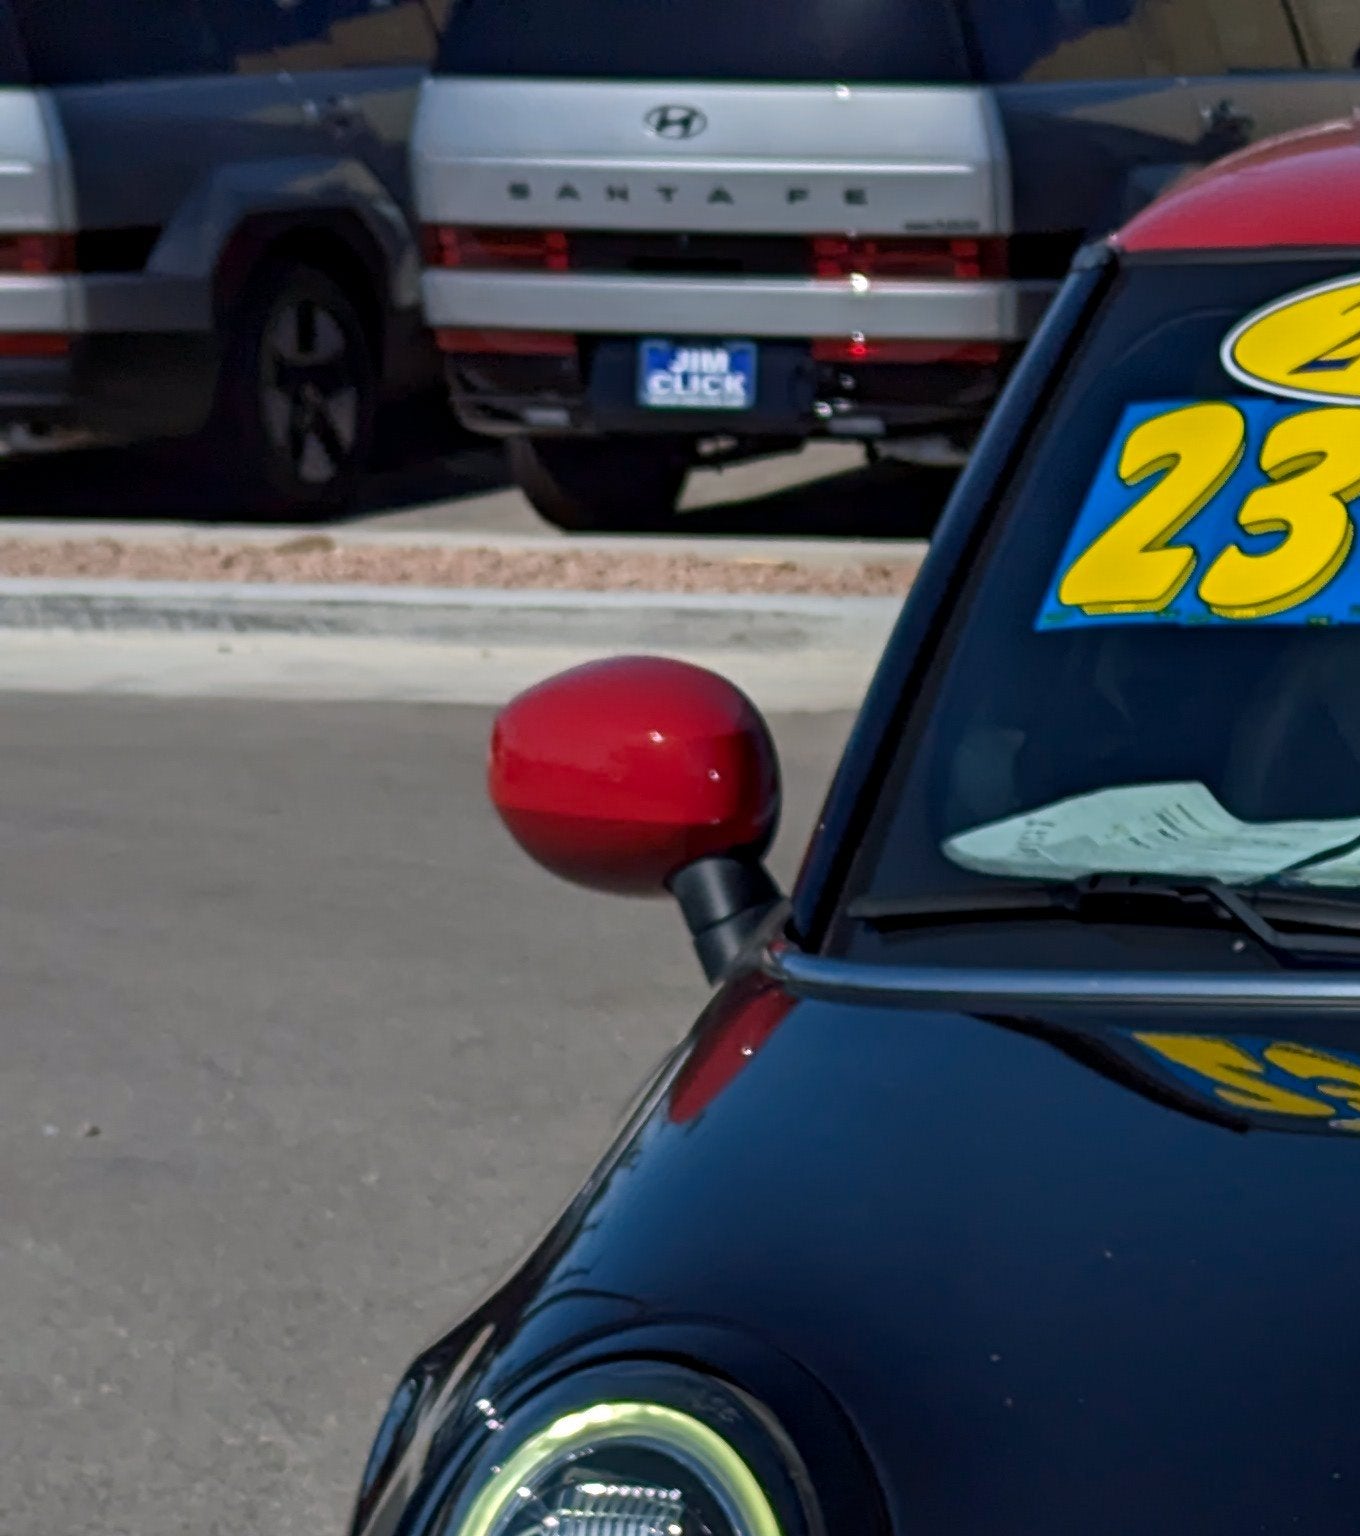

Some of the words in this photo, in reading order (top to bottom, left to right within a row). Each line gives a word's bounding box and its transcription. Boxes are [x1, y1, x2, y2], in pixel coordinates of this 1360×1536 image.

[508, 181, 735, 206] SANTA
[787, 188, 869, 206] FE
[669, 348, 729, 373] JIM
[647, 372, 746, 396] CLICK
